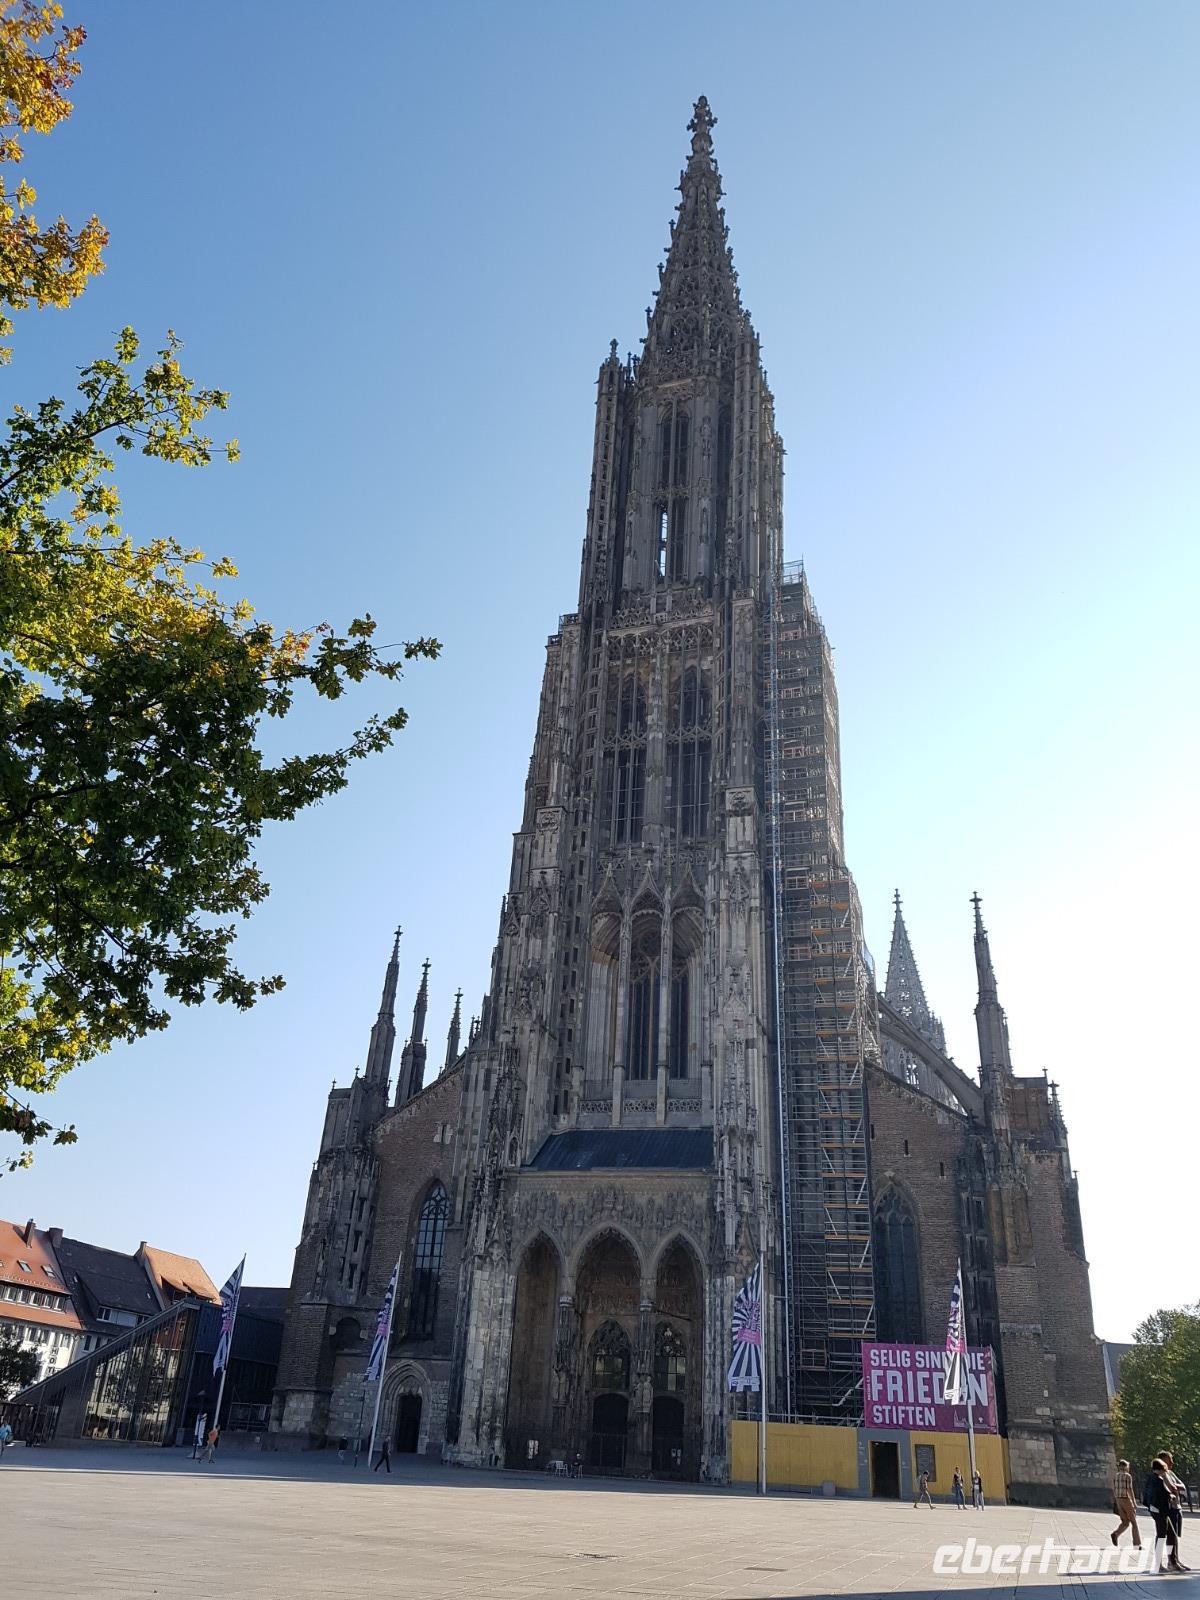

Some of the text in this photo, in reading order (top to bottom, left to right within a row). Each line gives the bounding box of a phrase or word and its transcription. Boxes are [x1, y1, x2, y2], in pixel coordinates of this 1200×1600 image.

[870, 1349, 911, 1368] SELIG
[871, 1369, 989, 1407] FRIEDN
[872, 1405, 936, 1427] STIFTEN
